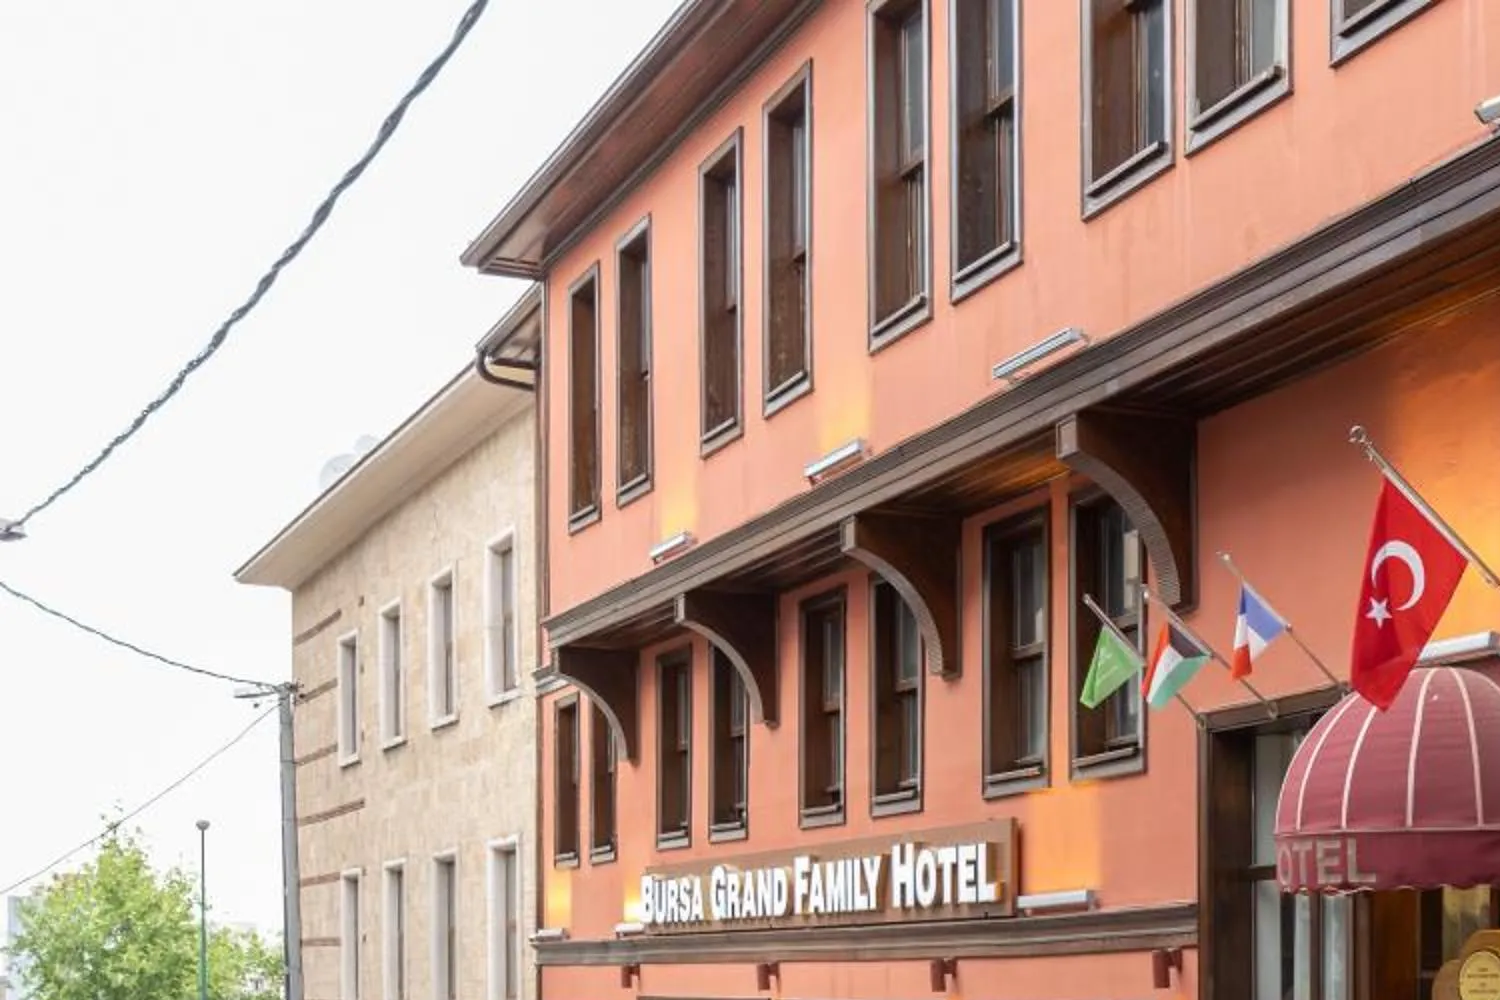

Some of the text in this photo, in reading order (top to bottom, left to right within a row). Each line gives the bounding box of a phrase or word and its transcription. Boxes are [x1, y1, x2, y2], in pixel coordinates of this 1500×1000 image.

[641, 842, 999, 923] BURSA GRAND FAMILY HOTEL
